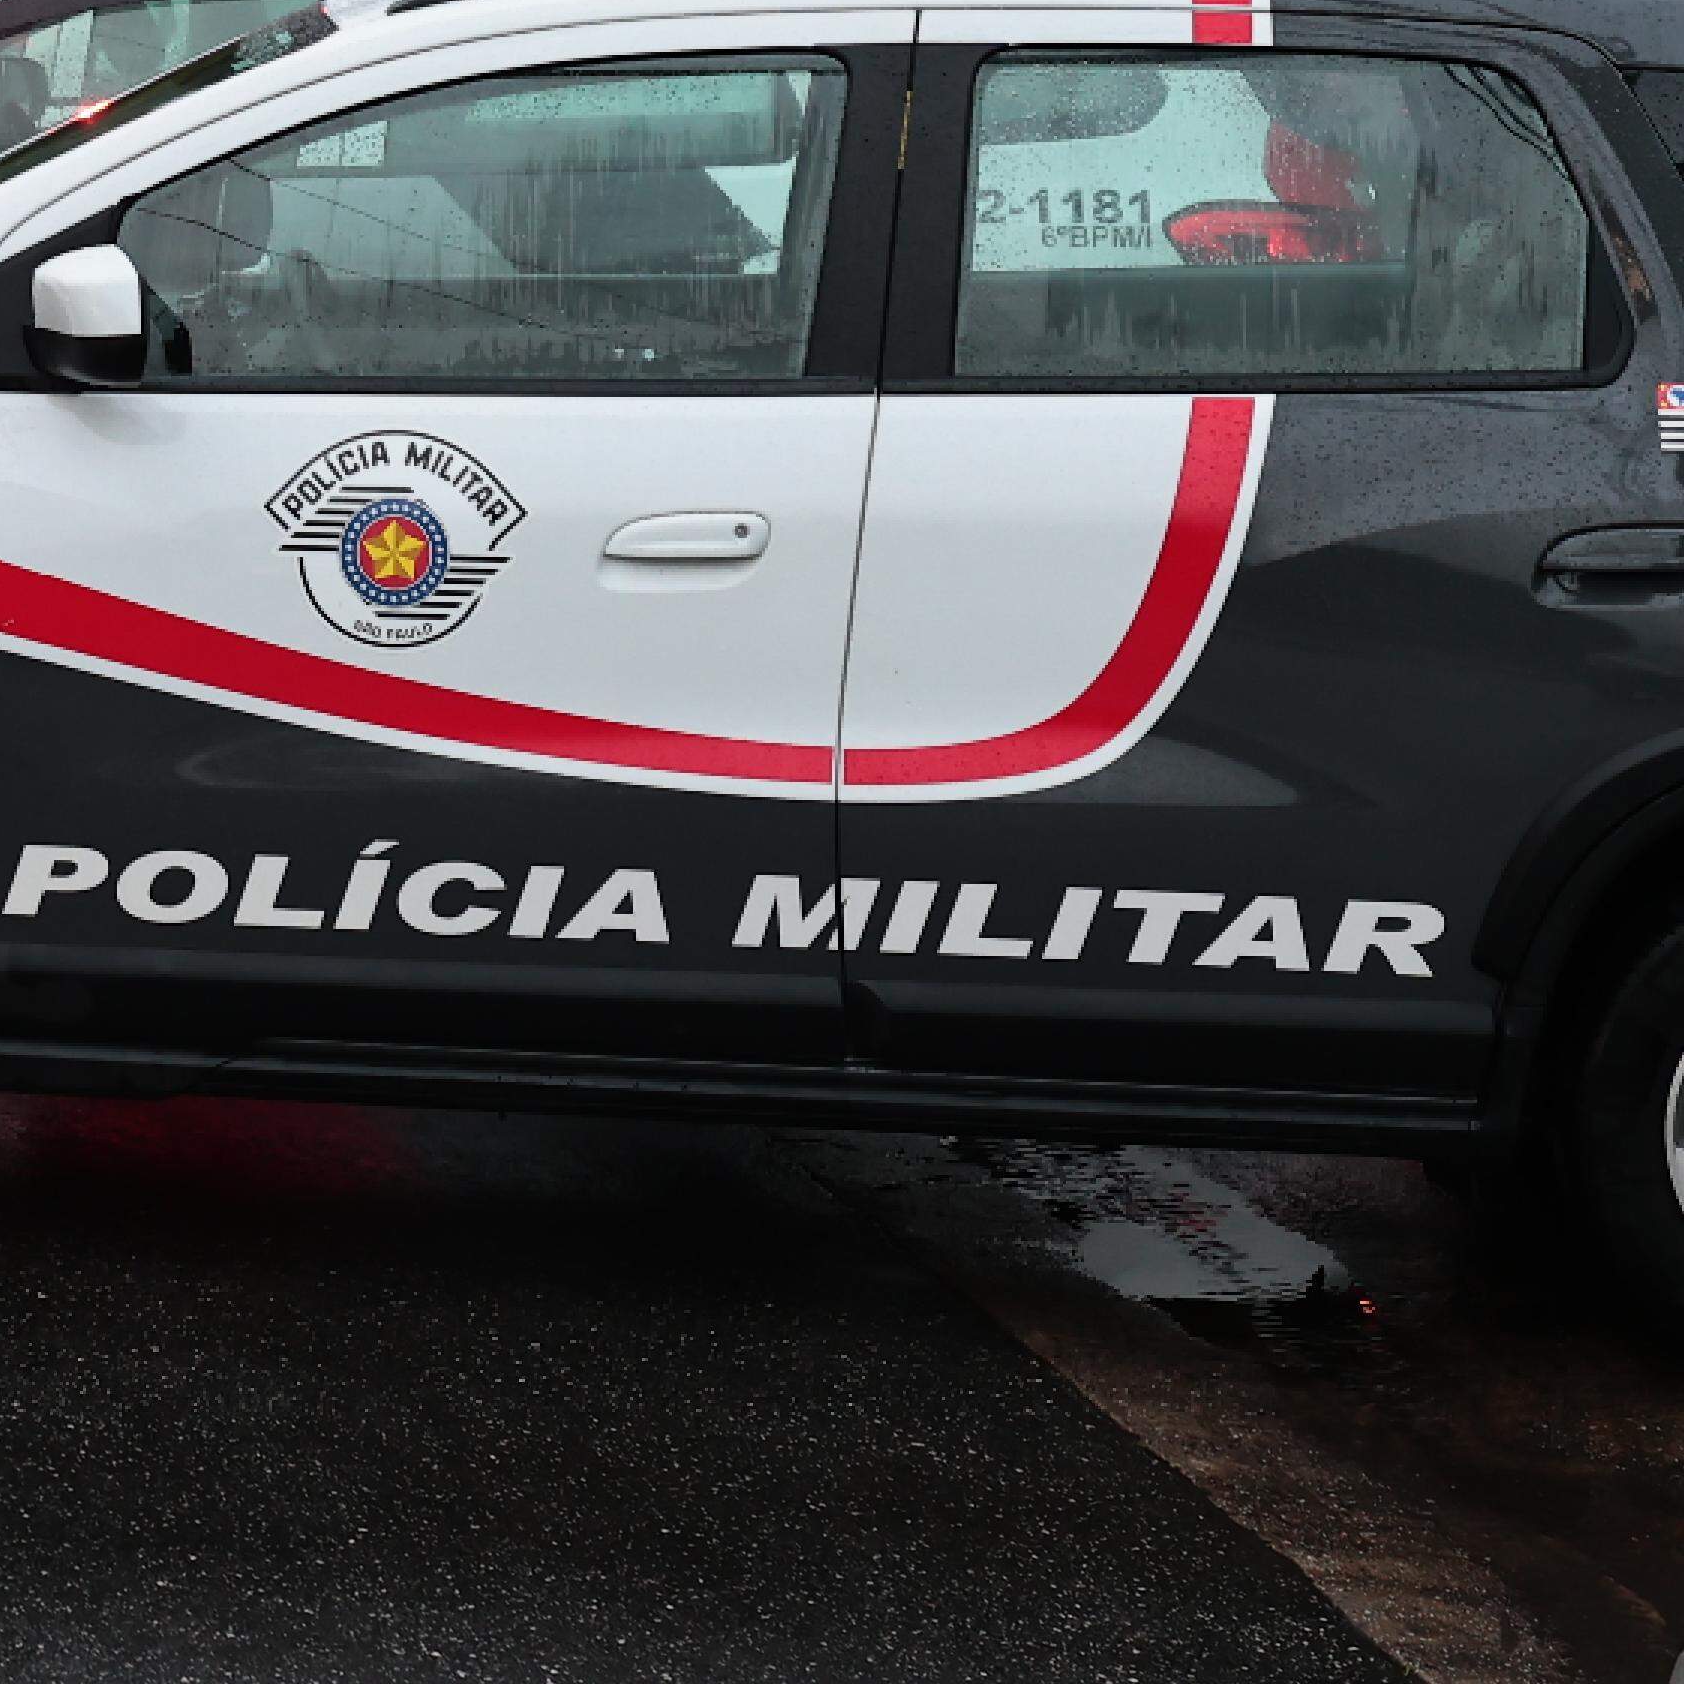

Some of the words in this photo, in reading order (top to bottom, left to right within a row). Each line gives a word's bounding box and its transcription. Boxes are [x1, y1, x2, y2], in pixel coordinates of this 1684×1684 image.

[404, 441, 508, 527] MILITAR
[1, 839, 669, 944] POLÍCIA
[731, 874, 1445, 978] MILITAR
